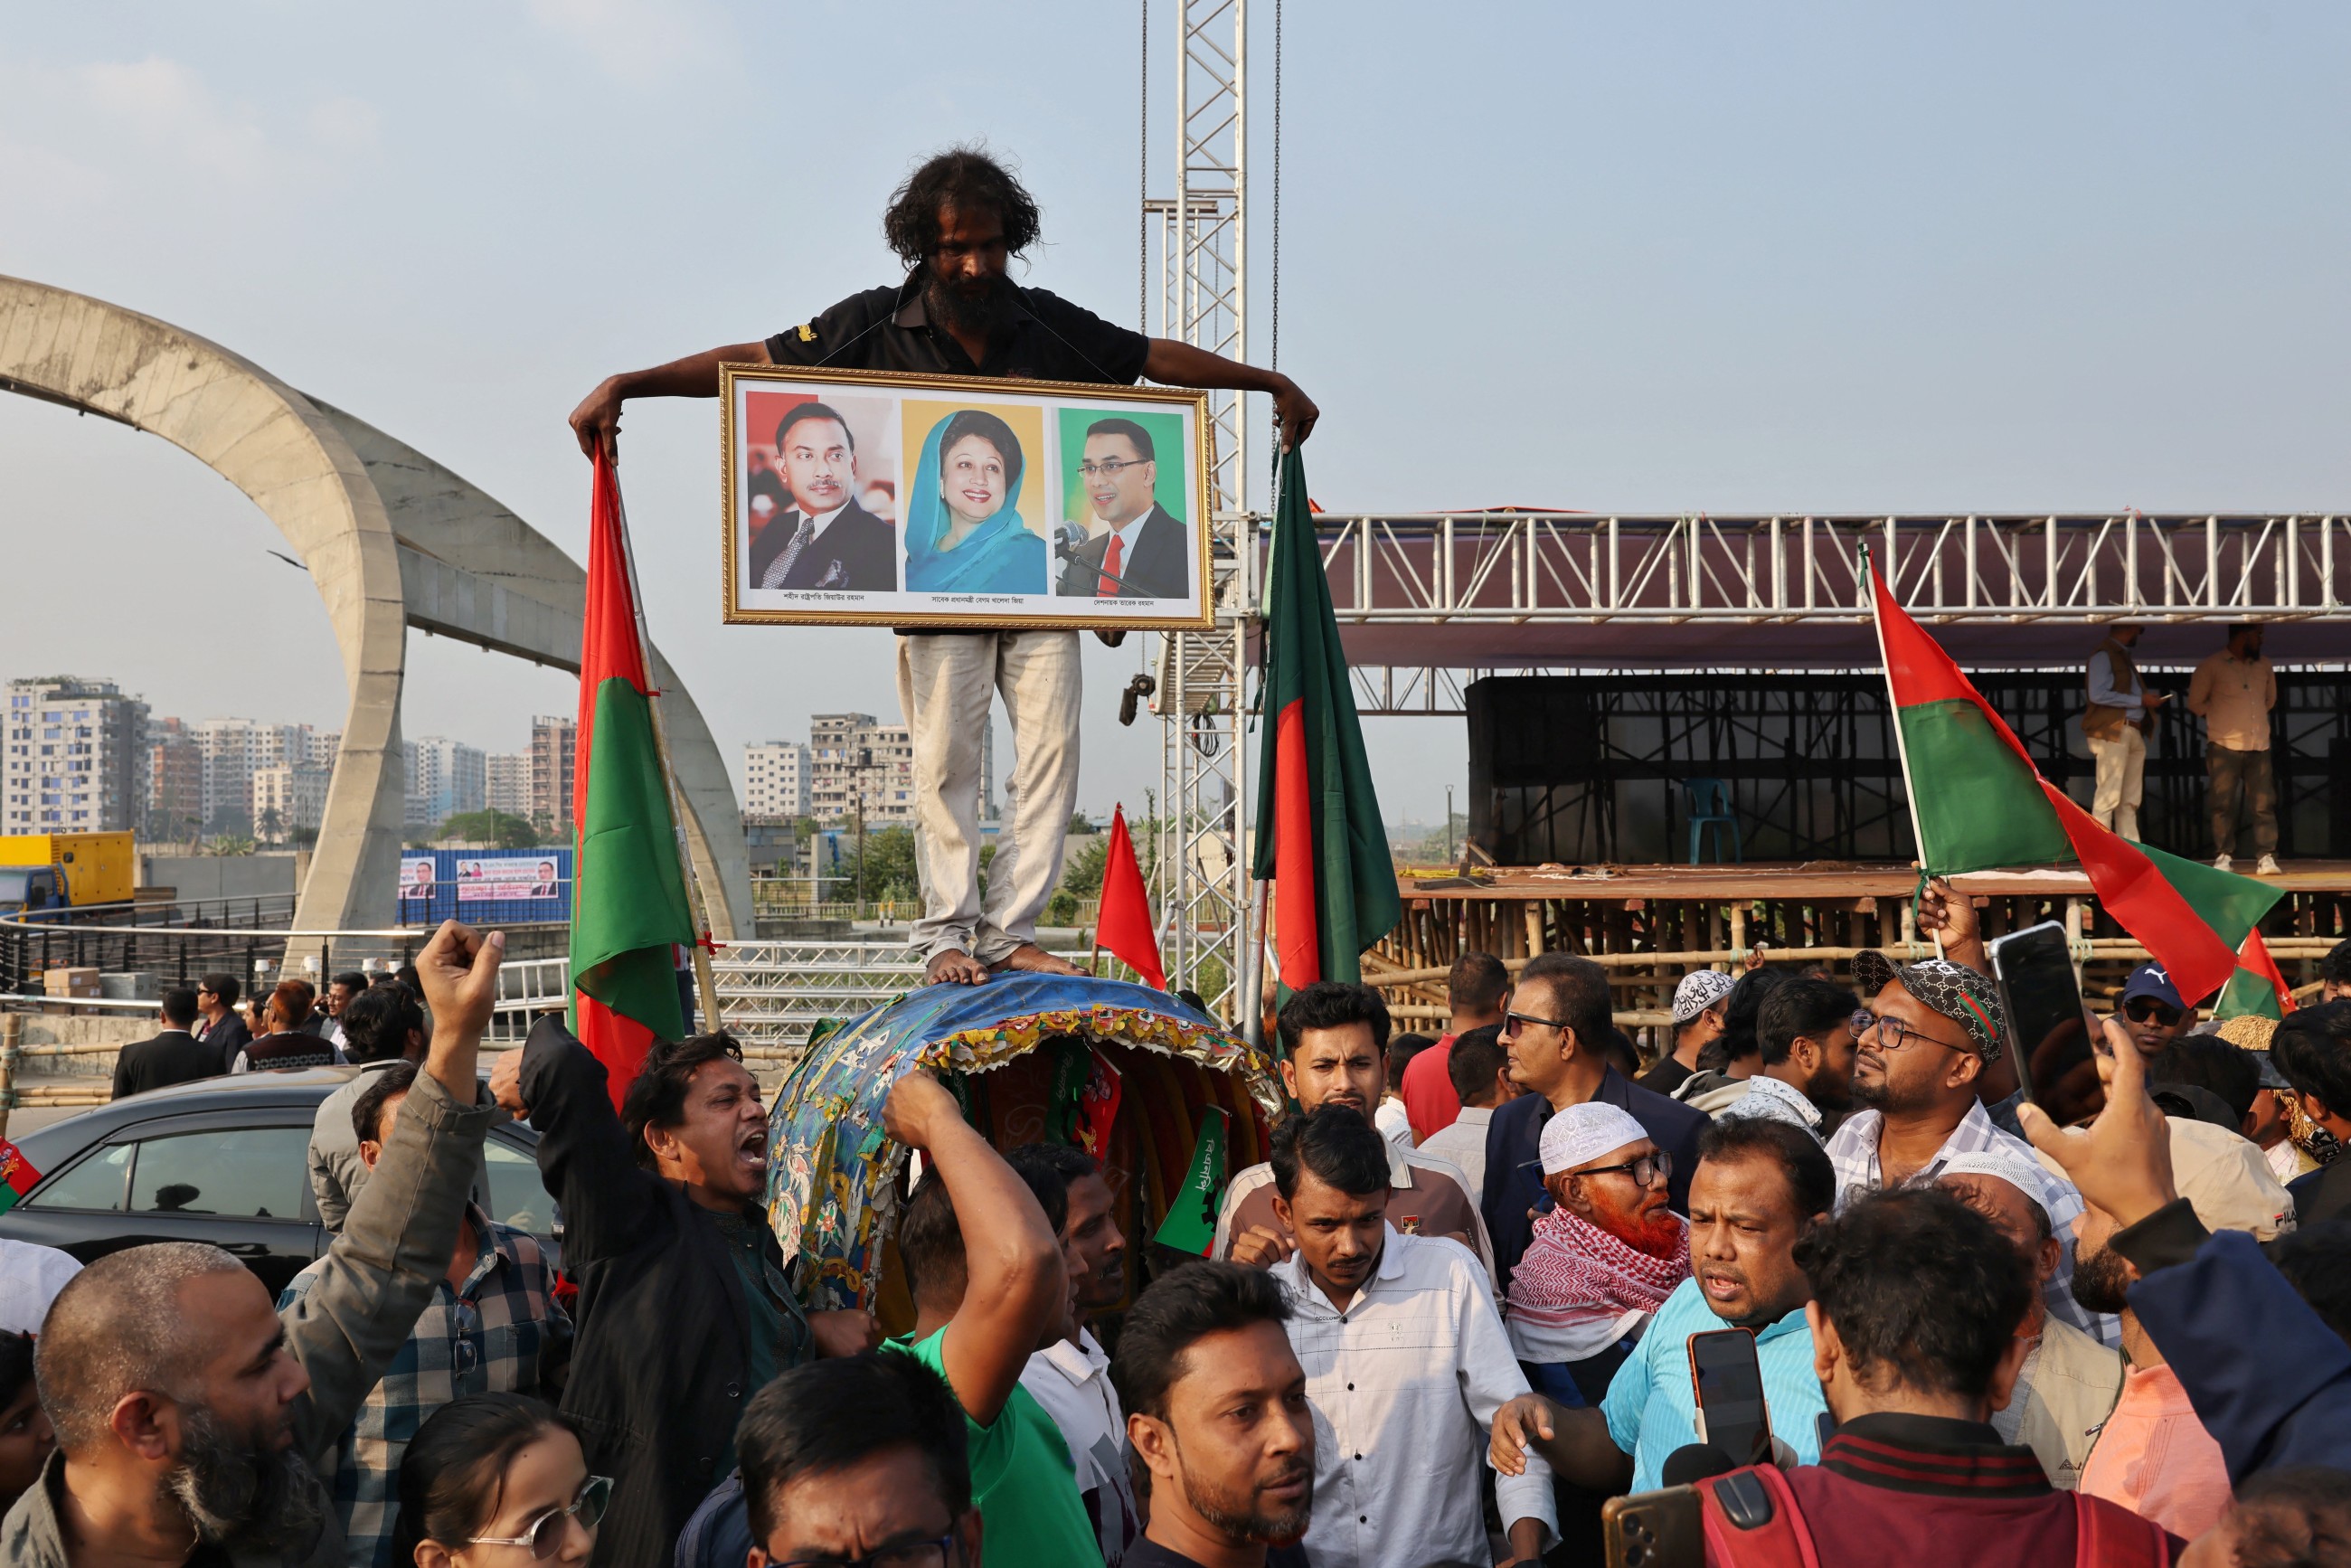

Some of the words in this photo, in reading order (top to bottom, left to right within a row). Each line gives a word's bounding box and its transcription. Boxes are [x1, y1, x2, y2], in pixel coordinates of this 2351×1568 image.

[783, 591, 798, 600] শহীদ
[800, 591, 822, 601] রাষ্ট্রপতি
[823, 592, 845, 600] জিয়াউর
[950, 595, 974, 604] প্রধানমন্ত্রী
[1011, 596, 1024, 604] জিয়া
[1195, 1138, 1215, 1192] বিএনপি
[1466, 1228, 1478, 1253] PREMIUM
